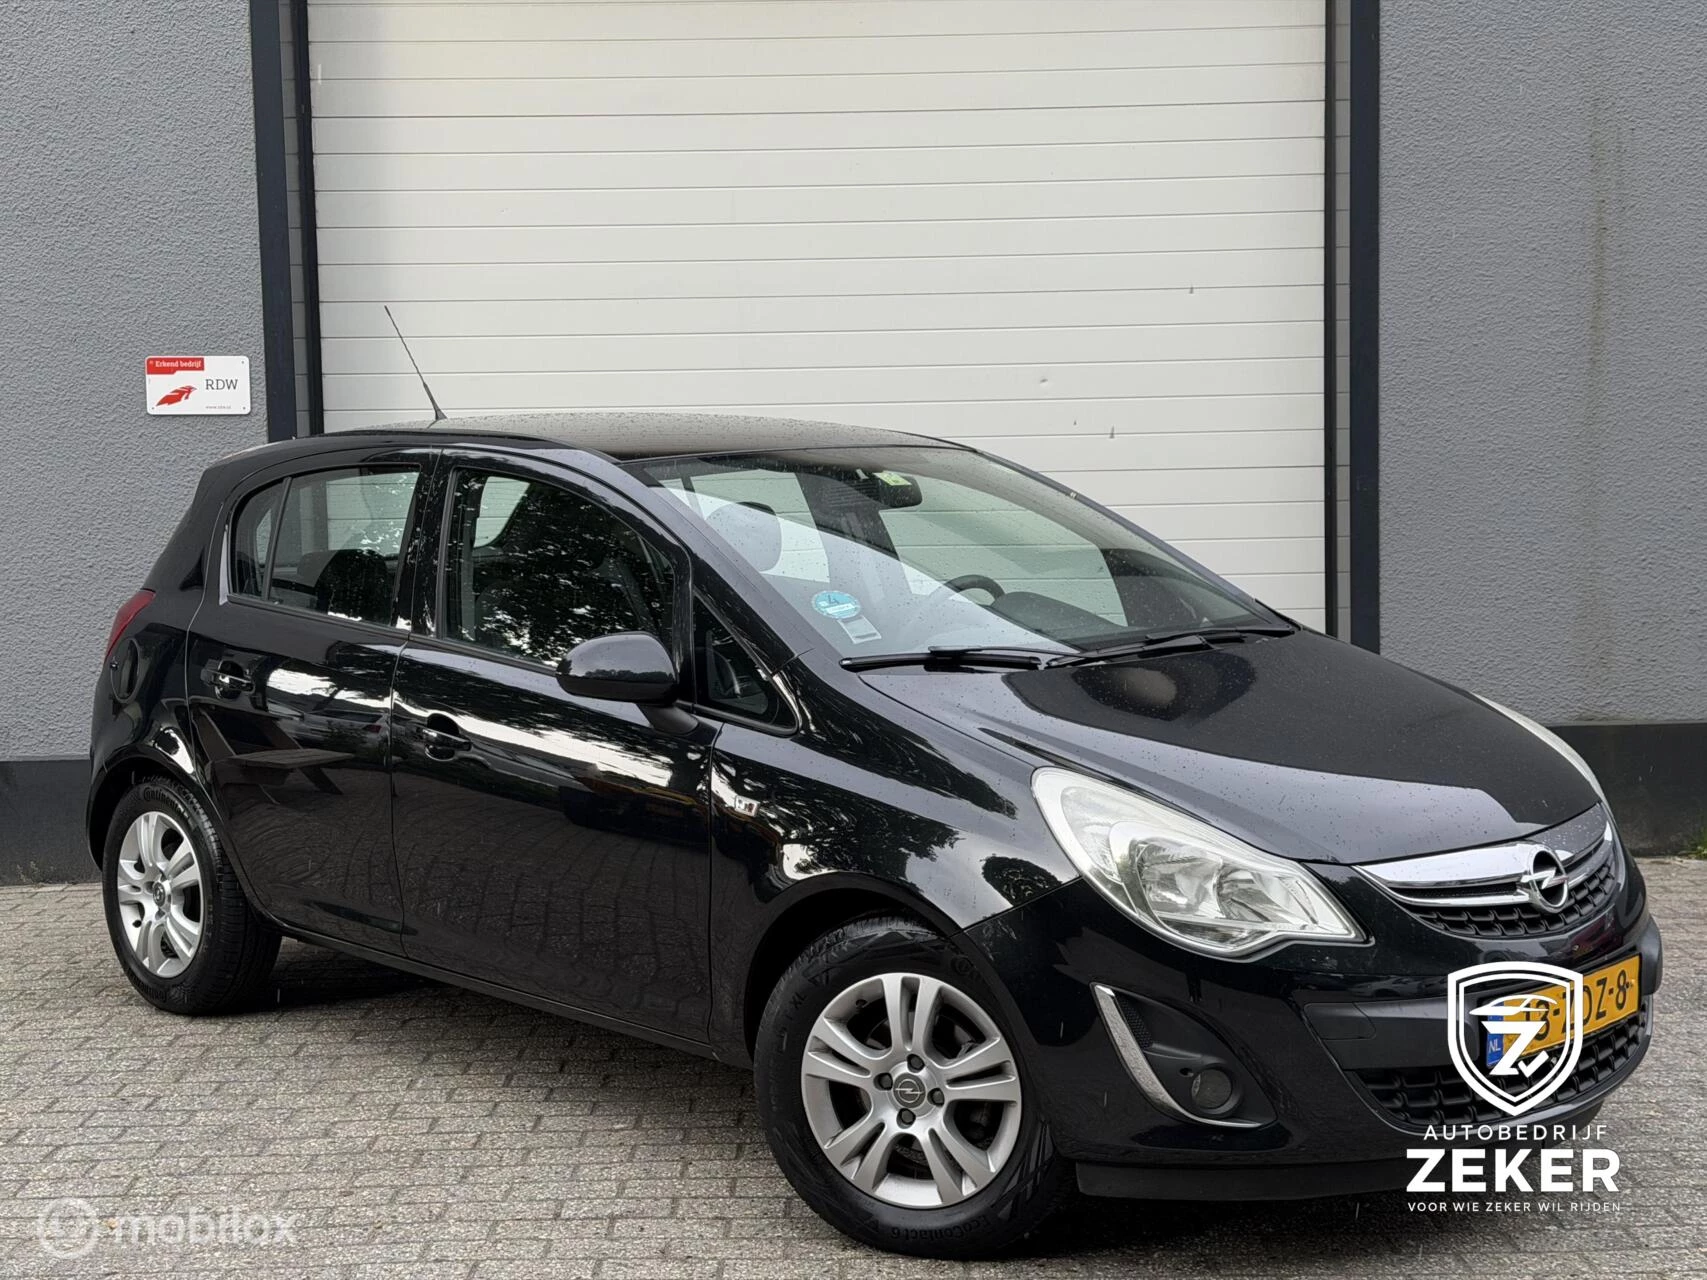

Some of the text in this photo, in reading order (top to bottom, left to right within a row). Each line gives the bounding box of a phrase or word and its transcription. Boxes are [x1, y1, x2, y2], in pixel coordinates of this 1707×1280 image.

[155, 360, 202, 369] Erkend bedrijf
[205, 378, 239, 391] RDW
[1488, 1039, 1502, 1053] NL
